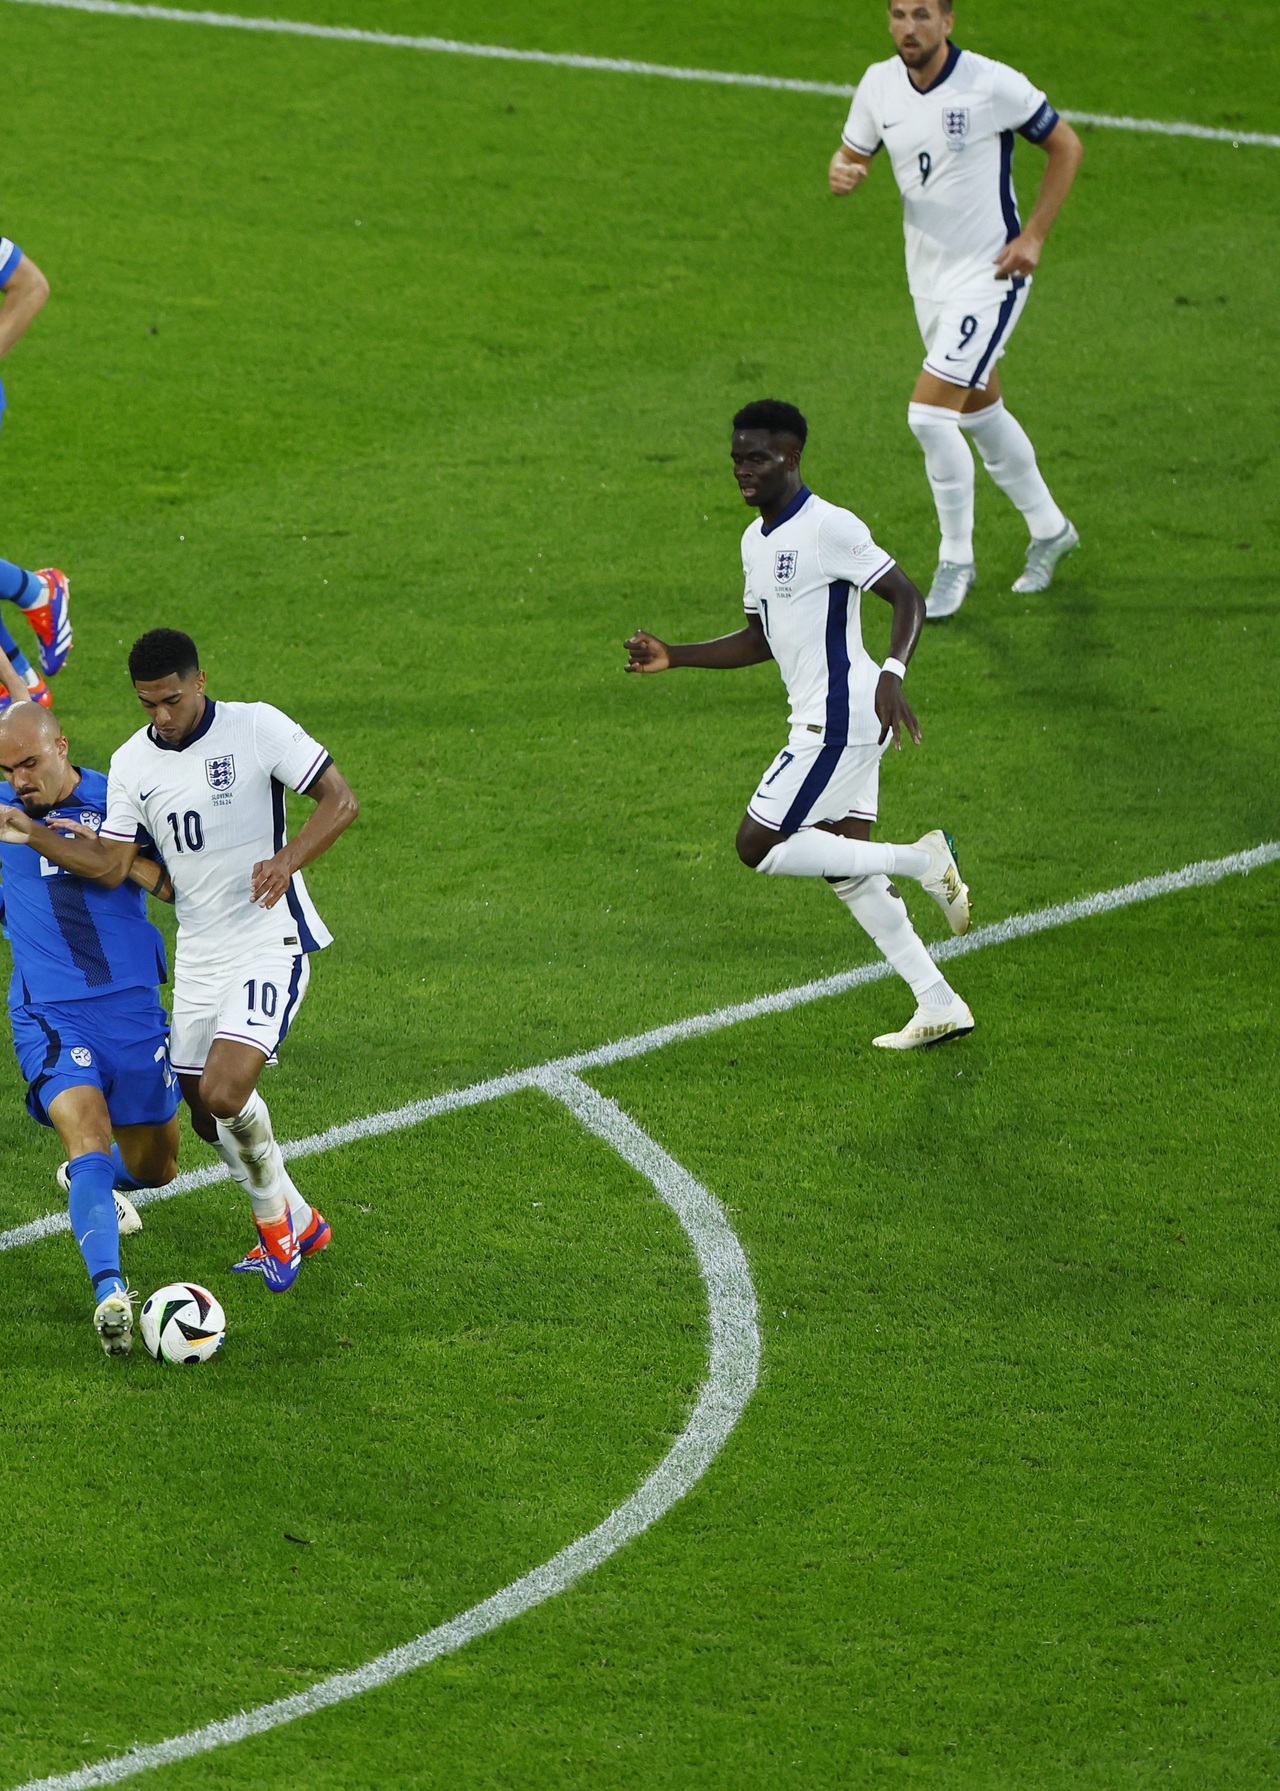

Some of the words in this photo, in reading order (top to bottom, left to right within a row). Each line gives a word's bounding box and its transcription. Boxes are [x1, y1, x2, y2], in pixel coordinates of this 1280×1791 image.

[918, 151, 932, 186] 9
[958, 315, 978, 350] 9
[765, 750, 795, 787] 7
[167, 810, 205, 854] 10
[243, 979, 277, 1018] 10
